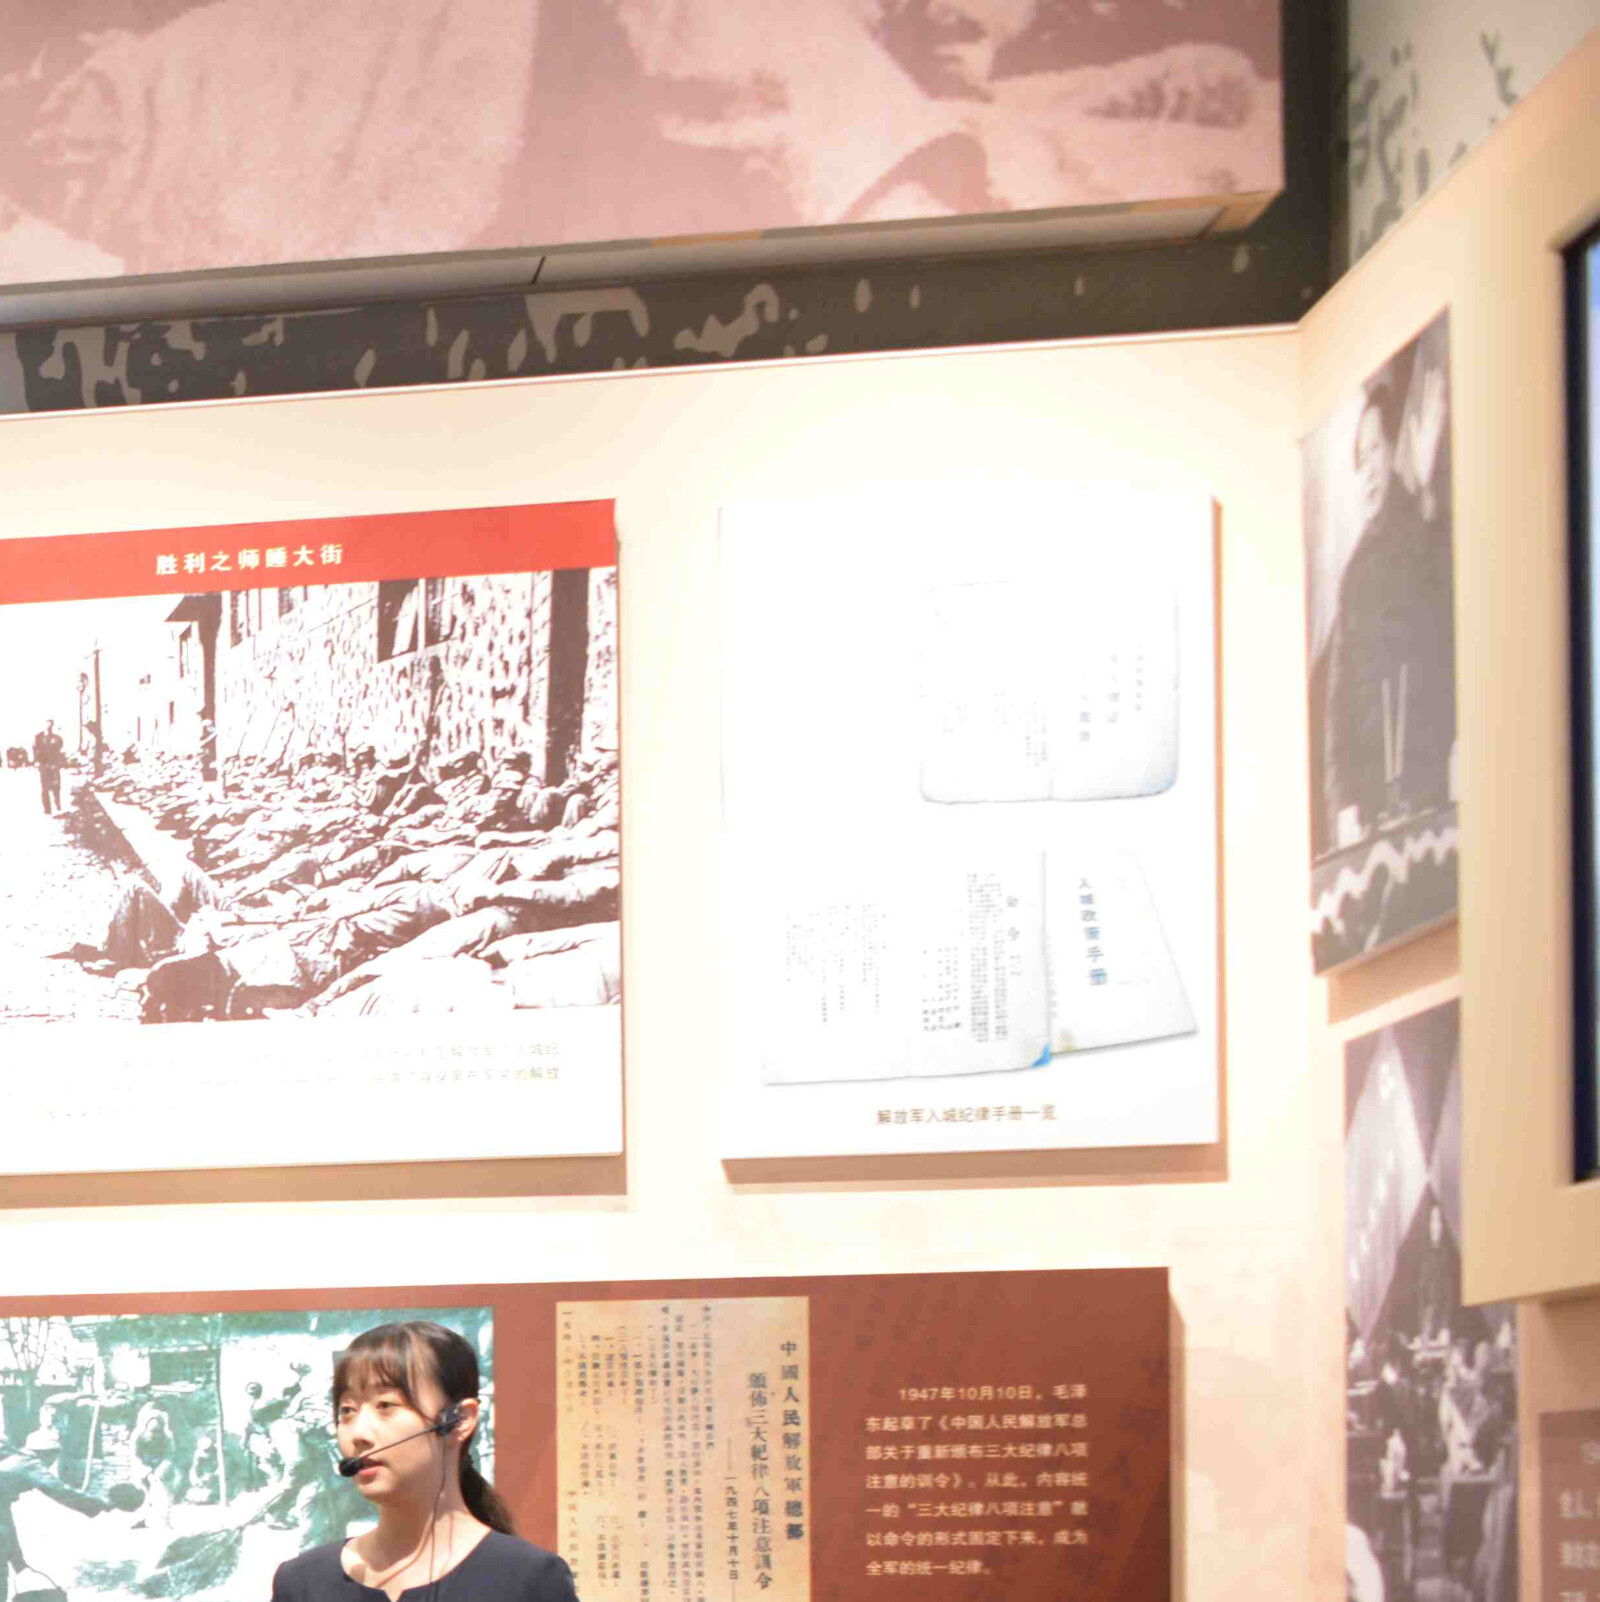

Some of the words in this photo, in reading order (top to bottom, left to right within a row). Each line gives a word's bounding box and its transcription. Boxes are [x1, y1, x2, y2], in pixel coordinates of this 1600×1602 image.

[156, 543, 344, 576] 胜利之师睡大街
[865, 1413, 1089, 1432] 东起草了《中国人民解放军总
[865, 1442, 1089, 1461] 部关于重新颁布三大纪律八项
